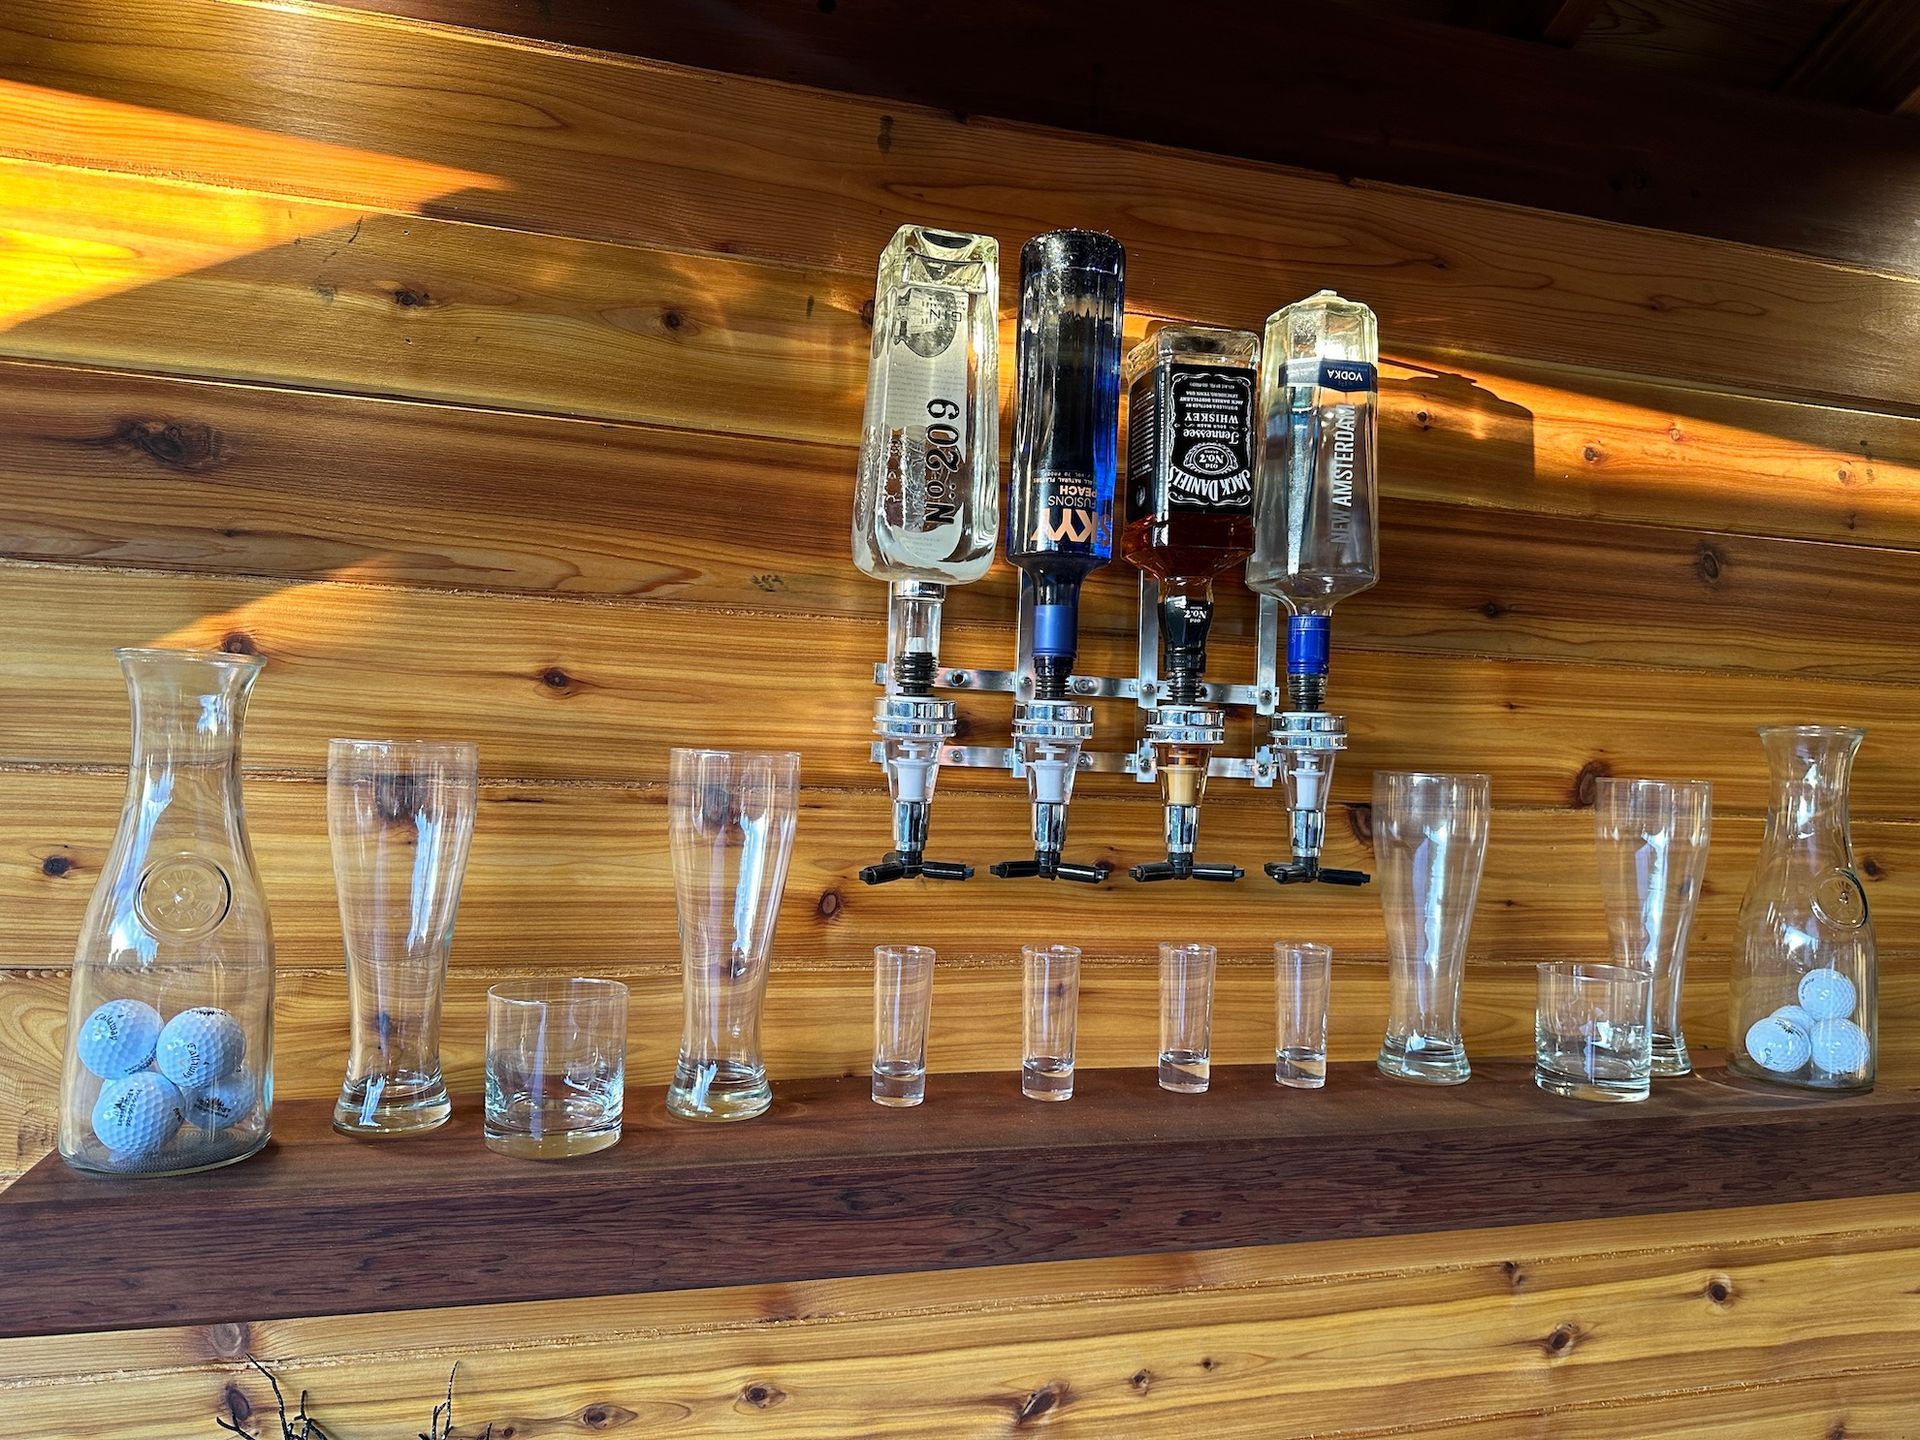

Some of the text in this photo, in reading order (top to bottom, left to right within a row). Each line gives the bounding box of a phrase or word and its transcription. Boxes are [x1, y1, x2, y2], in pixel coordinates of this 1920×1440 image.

[1326, 369, 1364, 382] VODKA
[1184, 412, 1239, 424] WHISKEY
[924, 398, 960, 472] 209
[1183, 428, 1240, 445] Tennessee
[1331, 403, 1356, 507] AMSTERDAM
[1059, 485, 1097, 498] PEACH
[1167, 466, 1219, 502] DANIEL'S
[1219, 469, 1251, 495] JACK
[1048, 495, 1096, 509] FUSIONS
[1030, 508, 1111, 547] SKYY
[1329, 508, 1352, 544] NEW
[94, 1012, 119, 1041] Callaway
